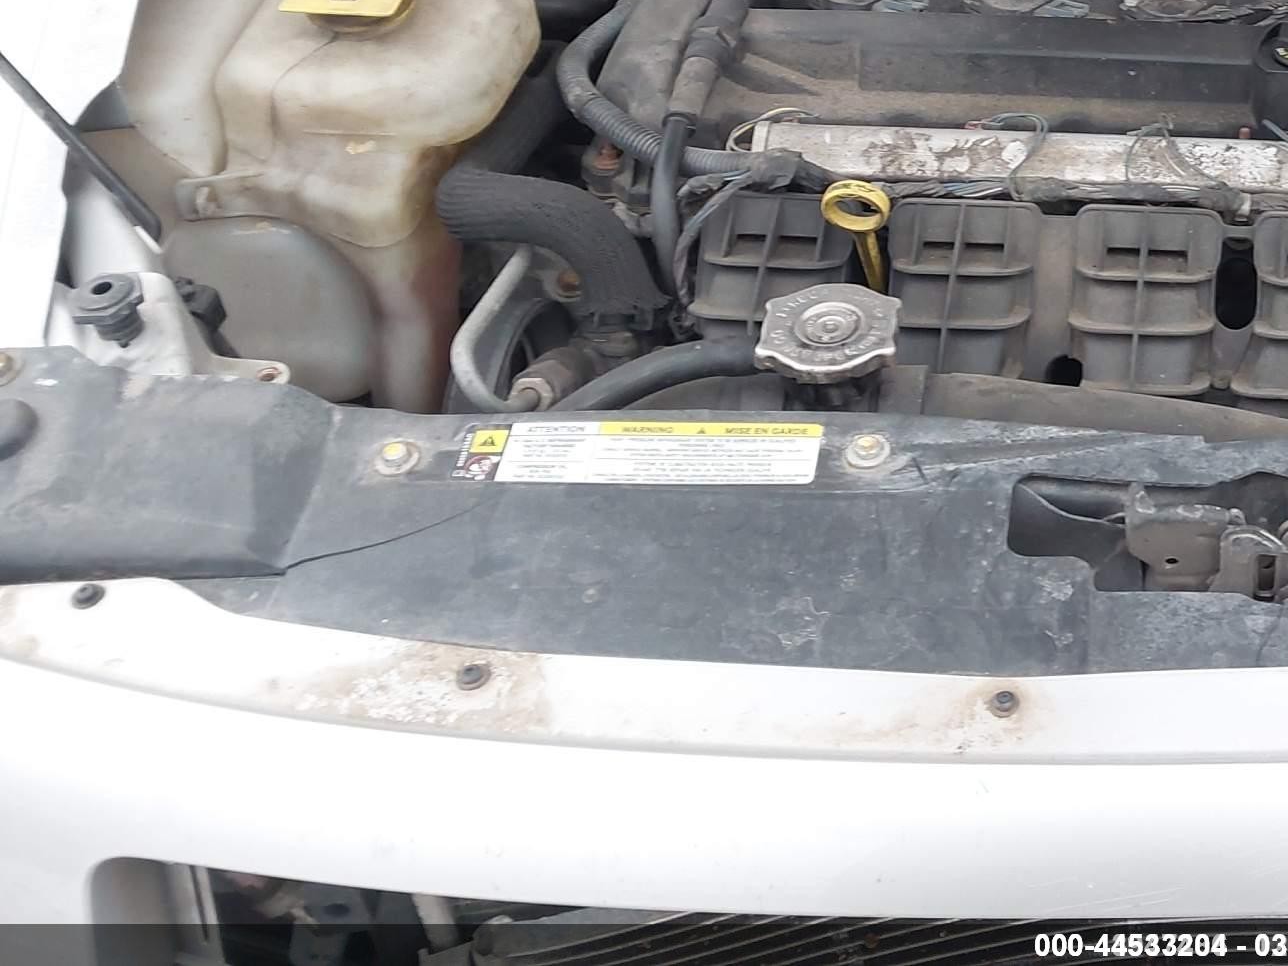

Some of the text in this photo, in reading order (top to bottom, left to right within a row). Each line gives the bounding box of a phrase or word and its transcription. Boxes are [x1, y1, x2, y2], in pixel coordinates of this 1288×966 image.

[620, 425, 675, 434] WARNING
[724, 427, 809, 436] MISE EN GARDE
